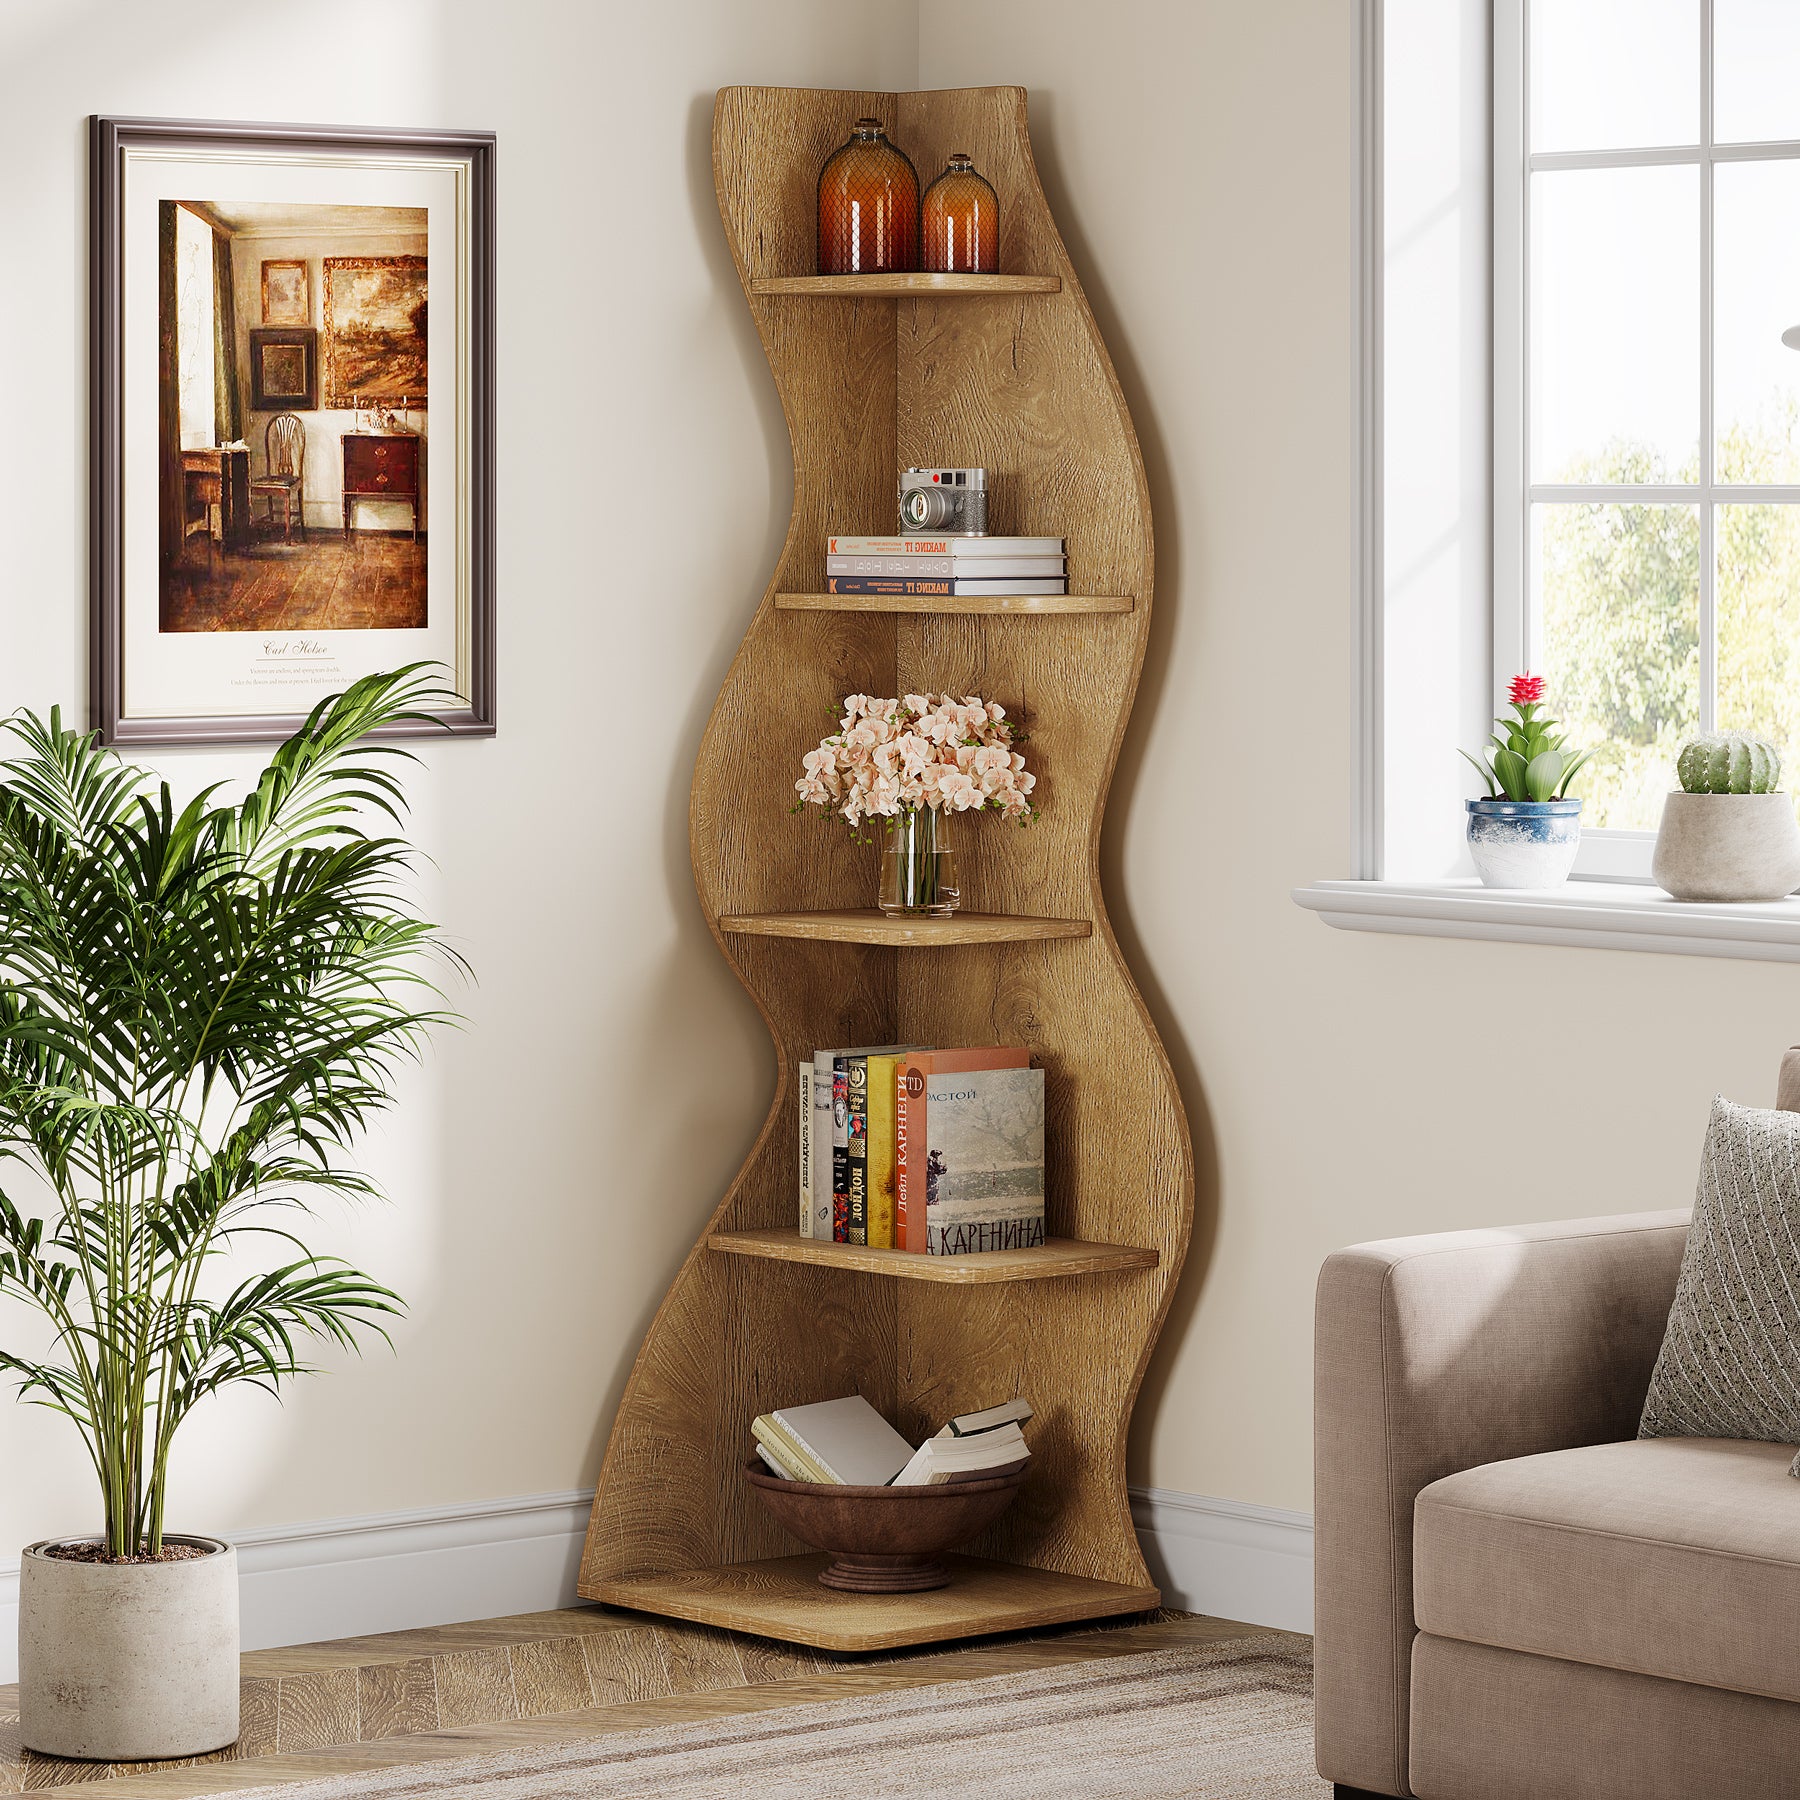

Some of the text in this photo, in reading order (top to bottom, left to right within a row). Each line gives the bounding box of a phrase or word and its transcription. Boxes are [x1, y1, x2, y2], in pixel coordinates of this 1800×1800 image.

[263, 640, 289, 656] Carl
[907, 1076, 923, 1091] TD
[897, 1075, 907, 1213] Дейл КАРНЕГИ
[852, 1167, 865, 1221] ЛОНДОН
[941, 1217, 1045, 1256] КАРЕНИНА
